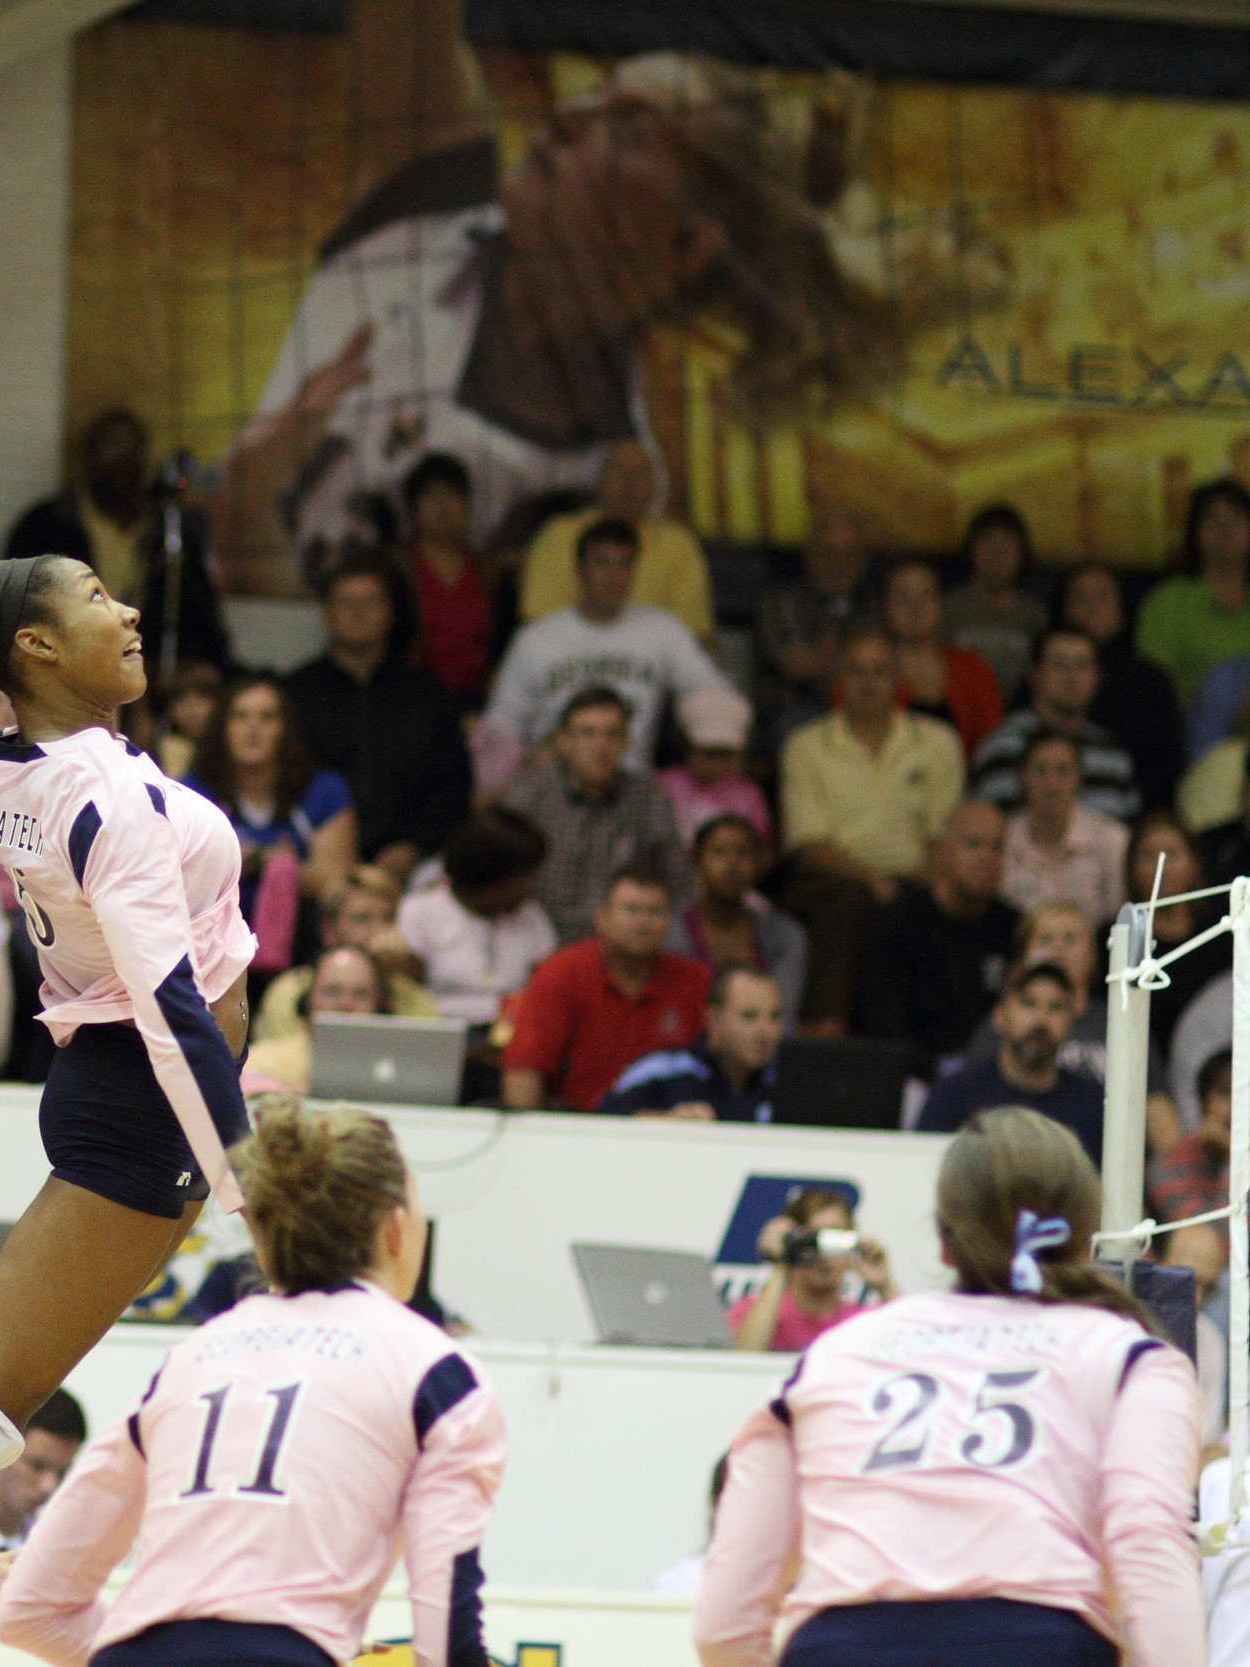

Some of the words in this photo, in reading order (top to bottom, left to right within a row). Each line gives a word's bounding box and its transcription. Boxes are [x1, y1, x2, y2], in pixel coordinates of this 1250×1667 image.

[935, 334, 1250, 406] ALEXA
[177, 1379, 302, 1500] 11
[857, 1367, 1044, 1473] 25
